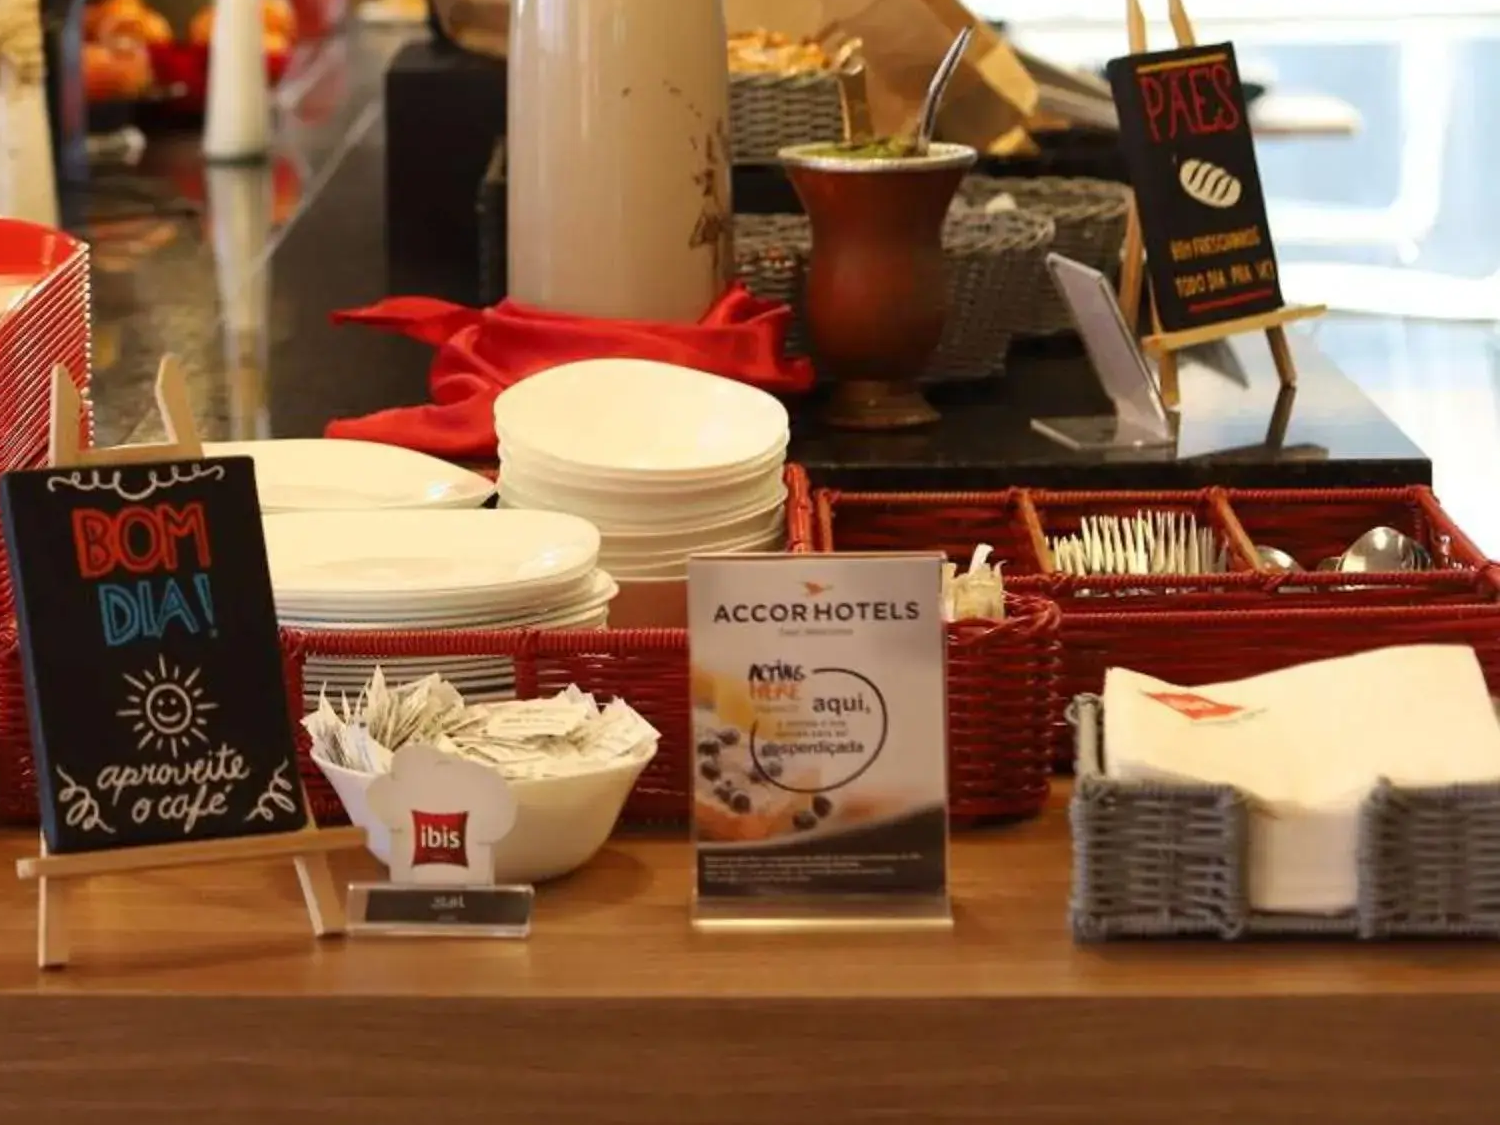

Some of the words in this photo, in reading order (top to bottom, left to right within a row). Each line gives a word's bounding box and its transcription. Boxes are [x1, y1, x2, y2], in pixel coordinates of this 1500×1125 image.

[71, 502, 211, 578] BOM
[98, 573, 218, 646] DIA!
[96, 742, 251, 807] aproveite
[131, 797, 153, 824] o
[158, 783, 234, 834] café
[420, 824, 462, 849] ibis
